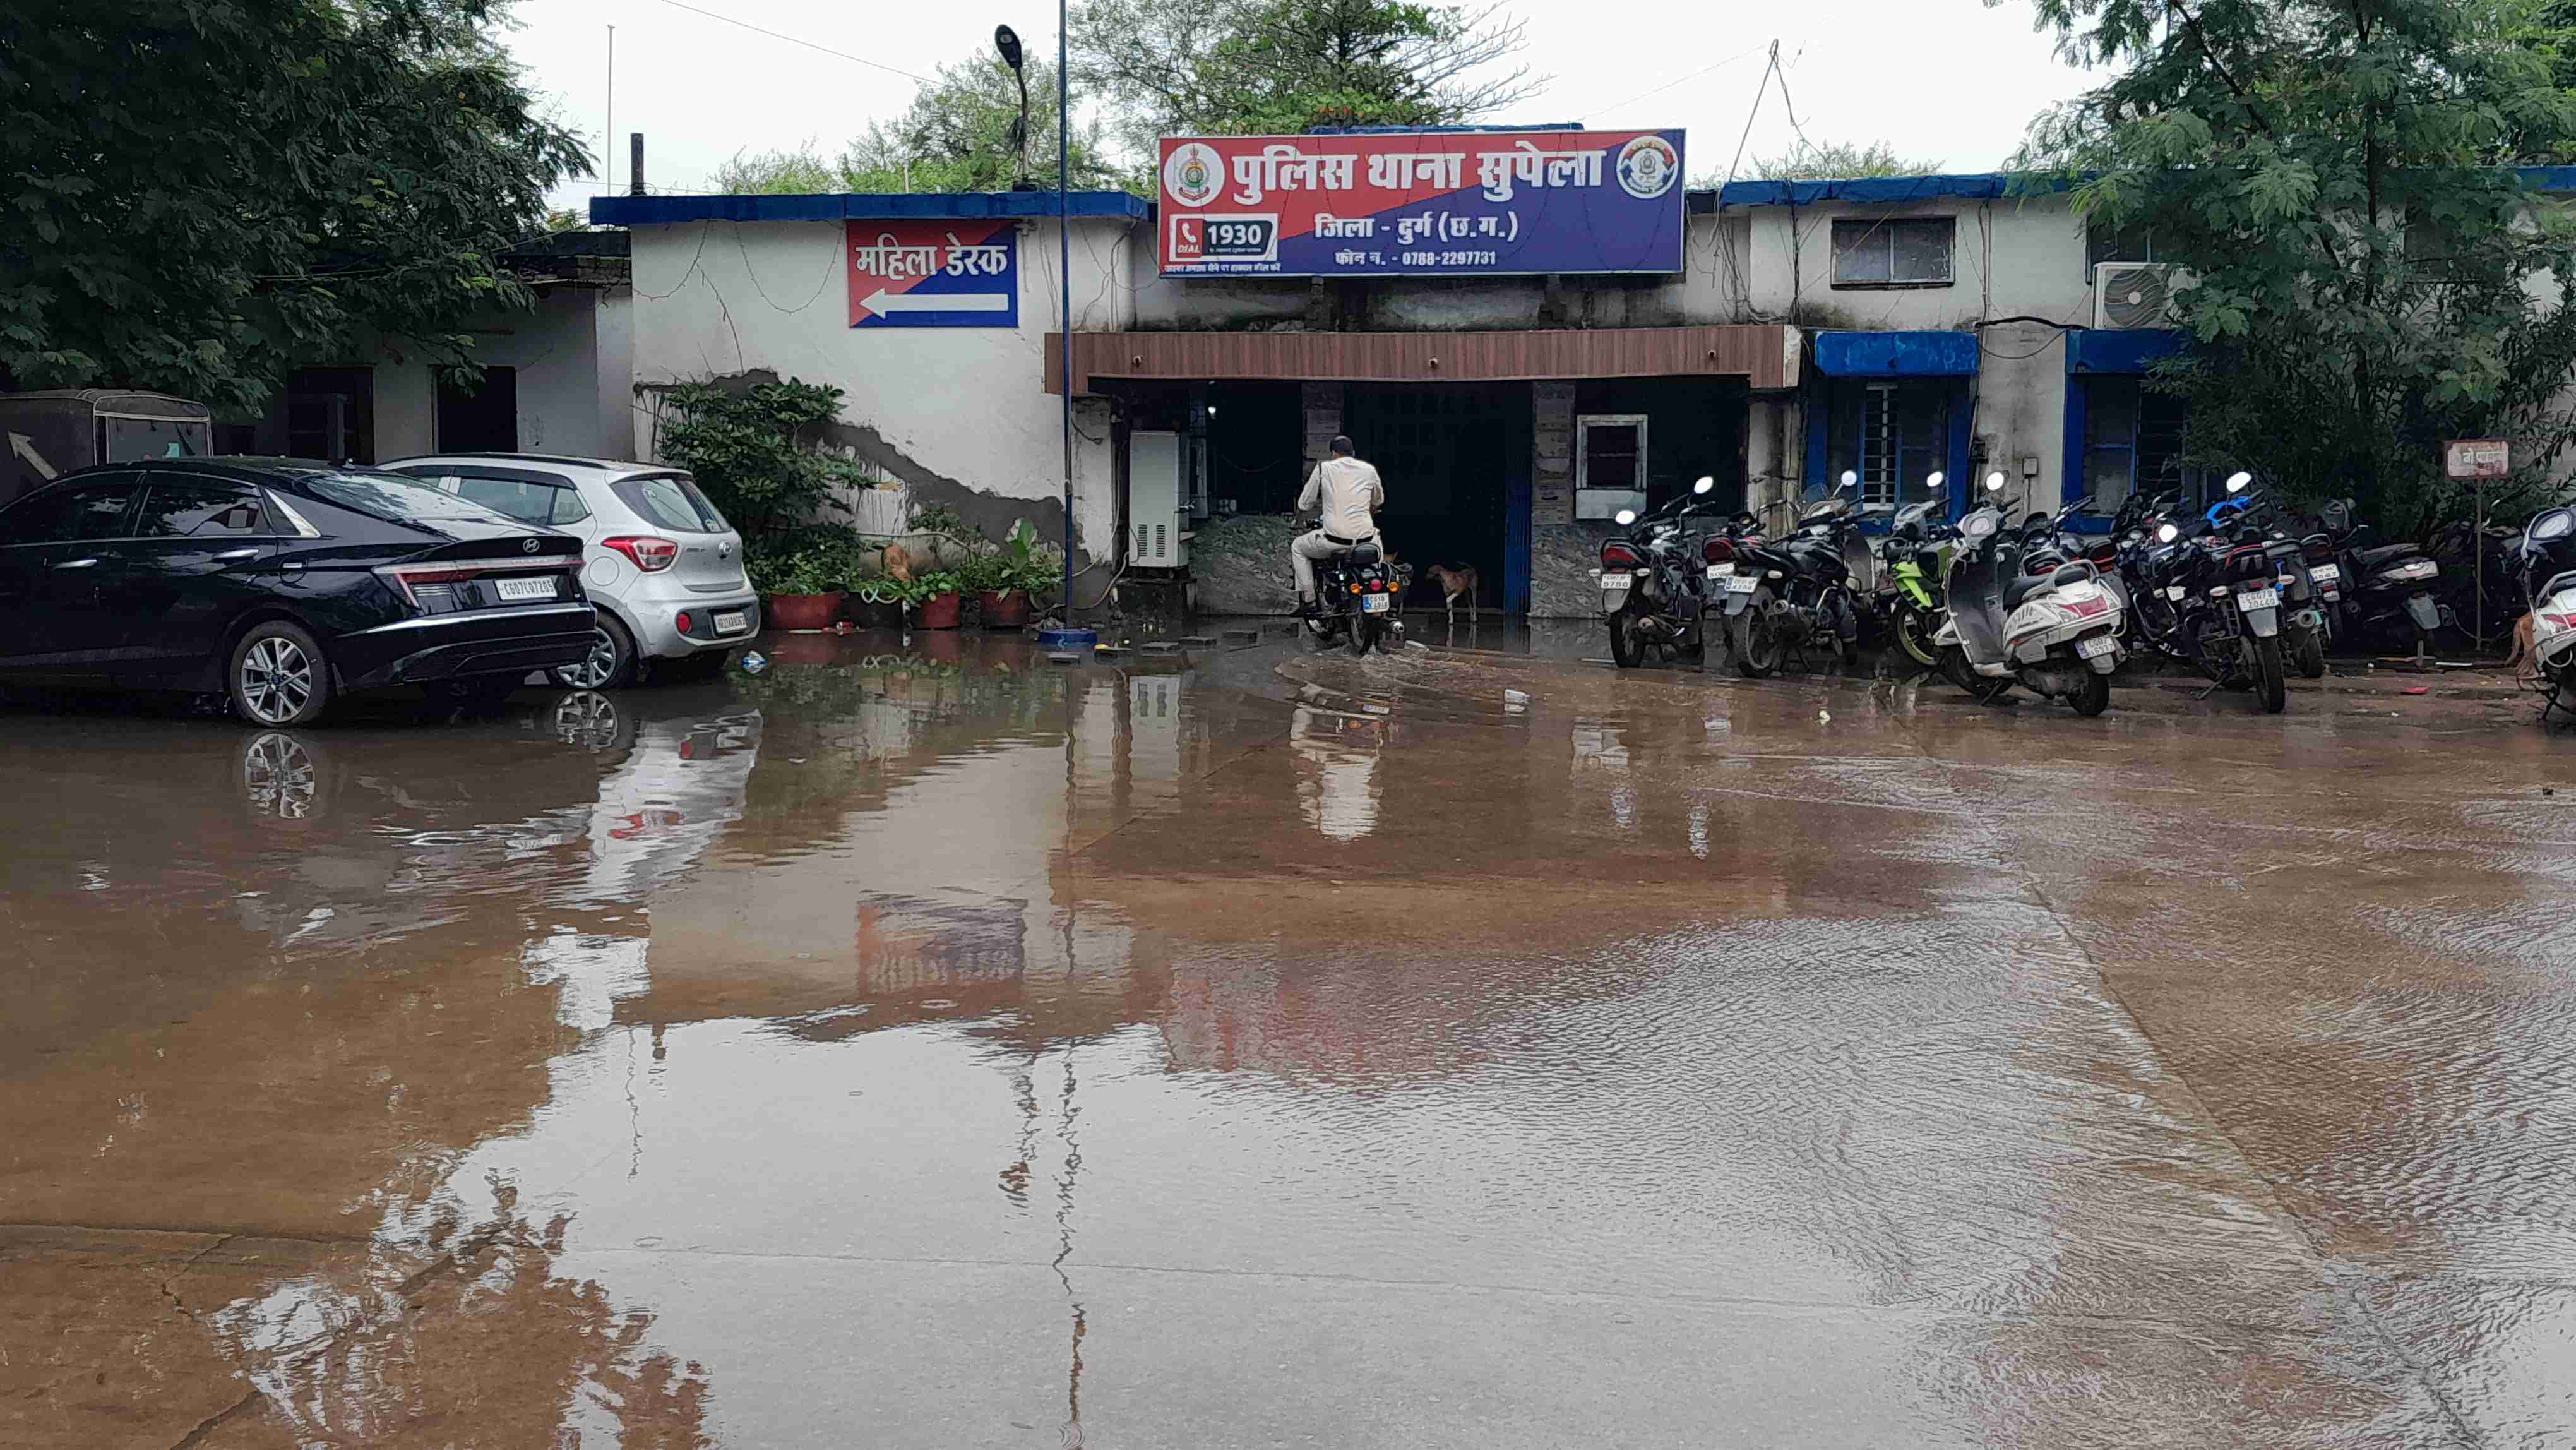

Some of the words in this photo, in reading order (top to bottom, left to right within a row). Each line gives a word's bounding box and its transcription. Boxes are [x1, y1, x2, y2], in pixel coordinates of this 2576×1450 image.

[1232, 144, 1358, 205] पुलिस
[1368, 153, 1465, 189] थाना
[1477, 140, 1607, 202] सुपेला
[1208, 224, 1261, 245] 1930
[1315, 213, 1375, 237] जिला
[856, 232, 938, 280] महिला
[1177, 244, 1200, 253] DIAL
[1335, 248, 1366, 265] फोन
[1402, 251, 1496, 266] 0788-2297731
